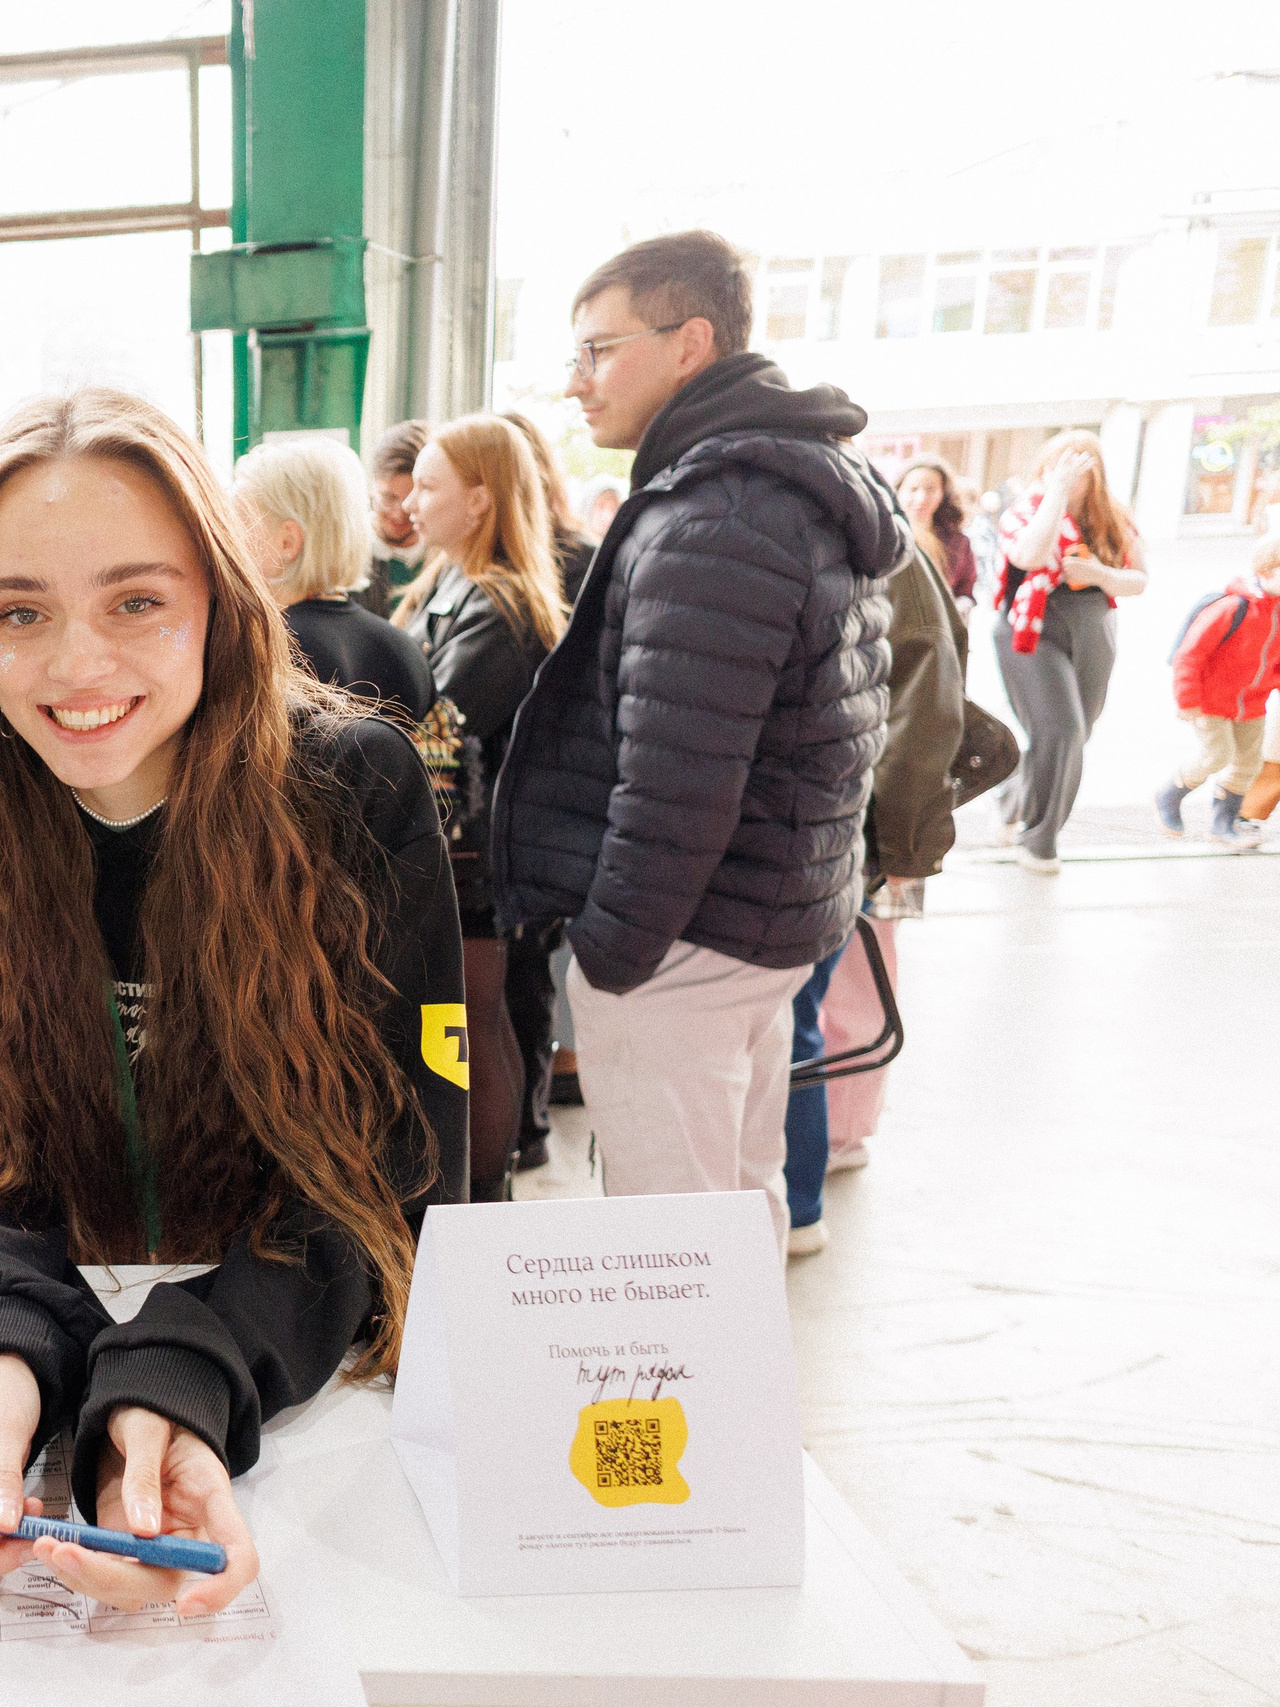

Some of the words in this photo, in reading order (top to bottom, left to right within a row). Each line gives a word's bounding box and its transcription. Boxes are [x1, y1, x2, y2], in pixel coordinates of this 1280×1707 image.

[506, 1251, 594, 1279] Сердца
[601, 1249, 712, 1270] слишком
[511, 1284, 583, 1309] много
[589, 1283, 617, 1303] не
[624, 1280, 711, 1302] бывает.
[548, 1343, 611, 1360] Помочь
[615, 1343, 625, 1356] и
[630, 1340, 669, 1356] быть
